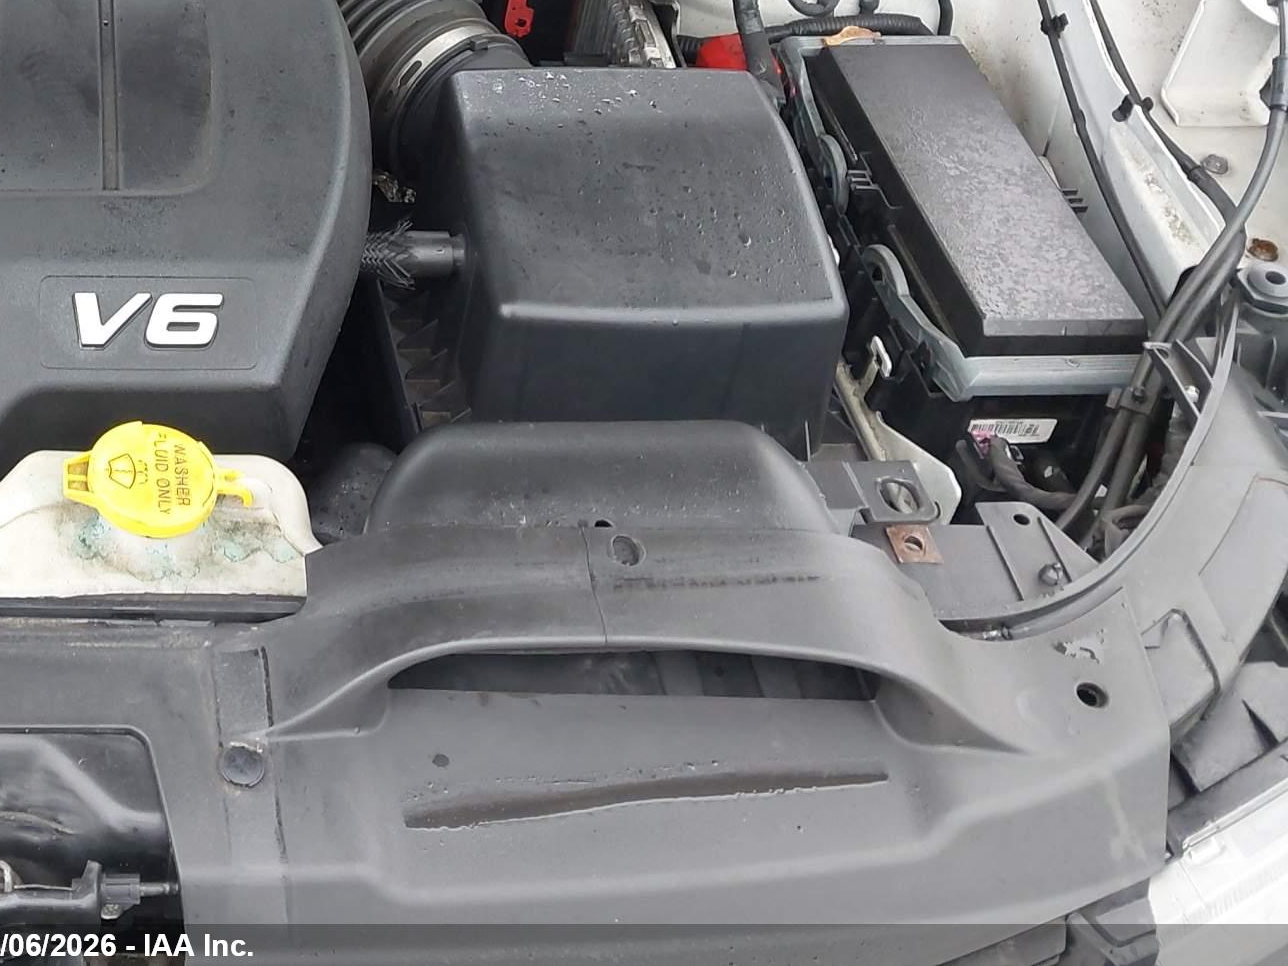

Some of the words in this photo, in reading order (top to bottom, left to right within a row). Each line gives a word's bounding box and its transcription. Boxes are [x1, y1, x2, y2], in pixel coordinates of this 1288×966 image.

[72, 292, 224, 349] V6
[153, 432, 169, 472] FLUID
[174, 443, 191, 506] WASHER
[156, 477, 172, 515] ONLY
